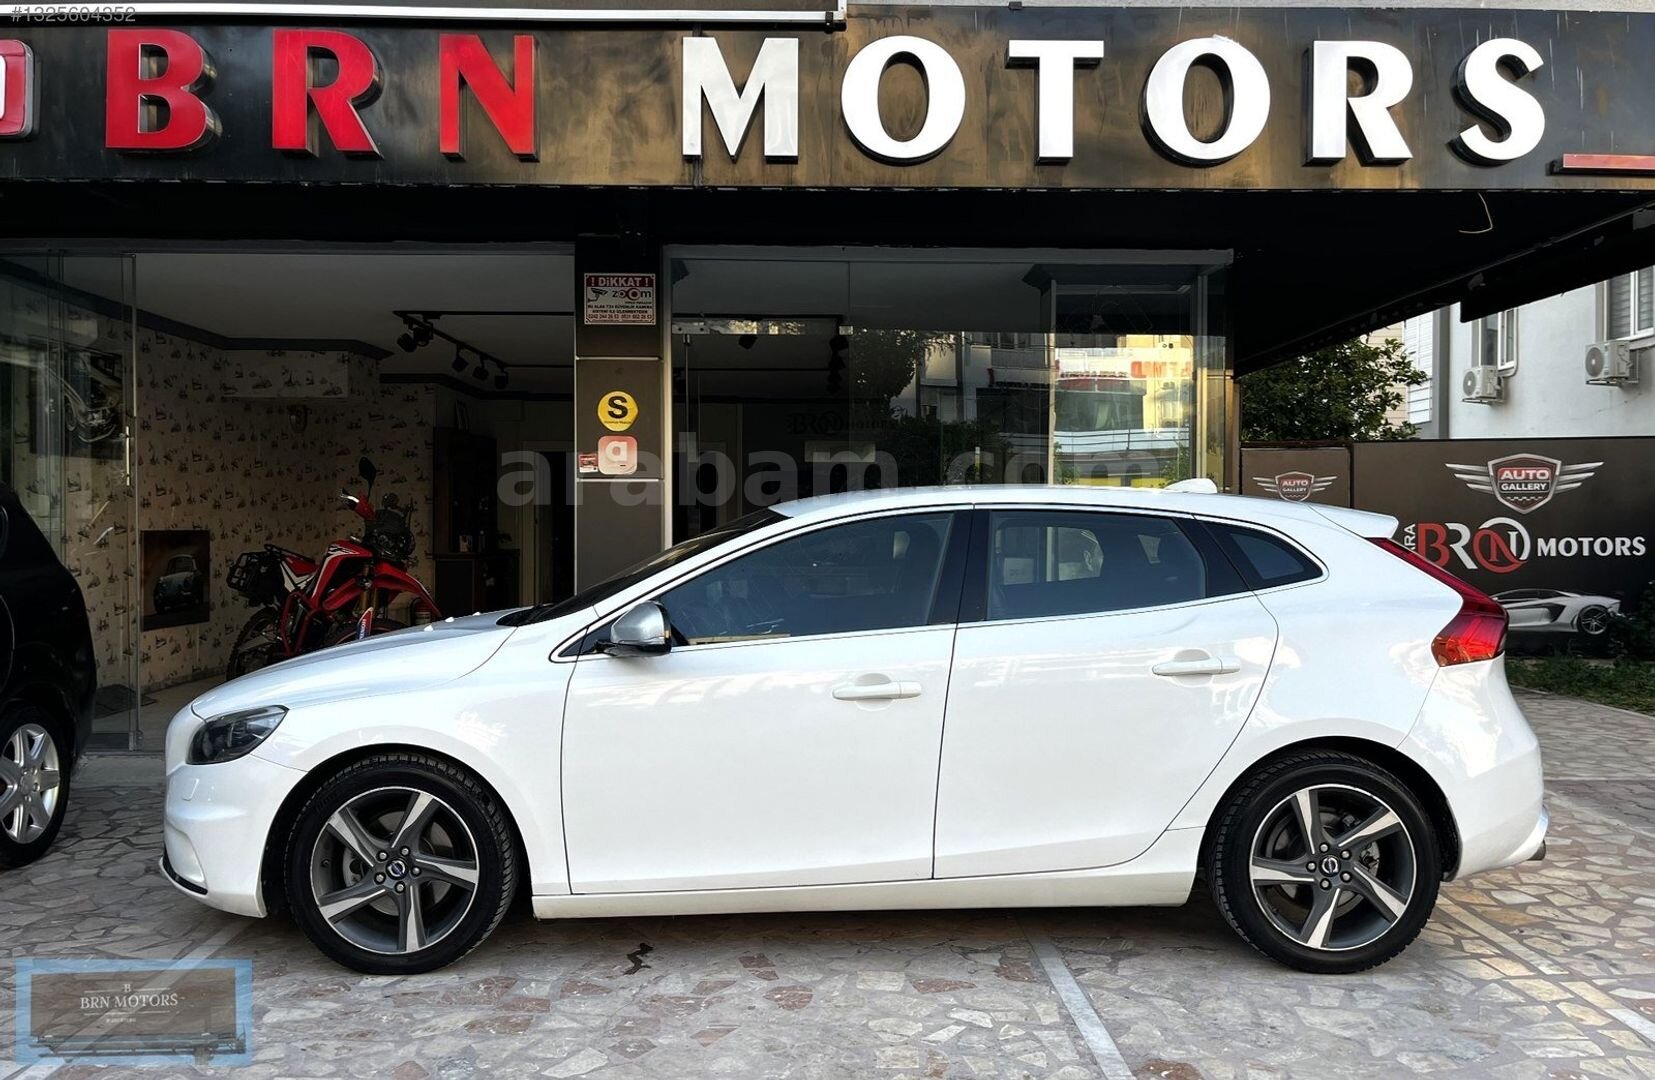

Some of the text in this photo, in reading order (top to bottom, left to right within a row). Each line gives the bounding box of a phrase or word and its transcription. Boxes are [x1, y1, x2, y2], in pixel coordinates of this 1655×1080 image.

[105, 29, 1547, 164] BRN MOTORS
[607, 395, 629, 419] S
[1501, 470, 1549, 480] AUTO
[1501, 483, 1547, 491] GALLERY
[1537, 537, 1646, 557] MOTORS
